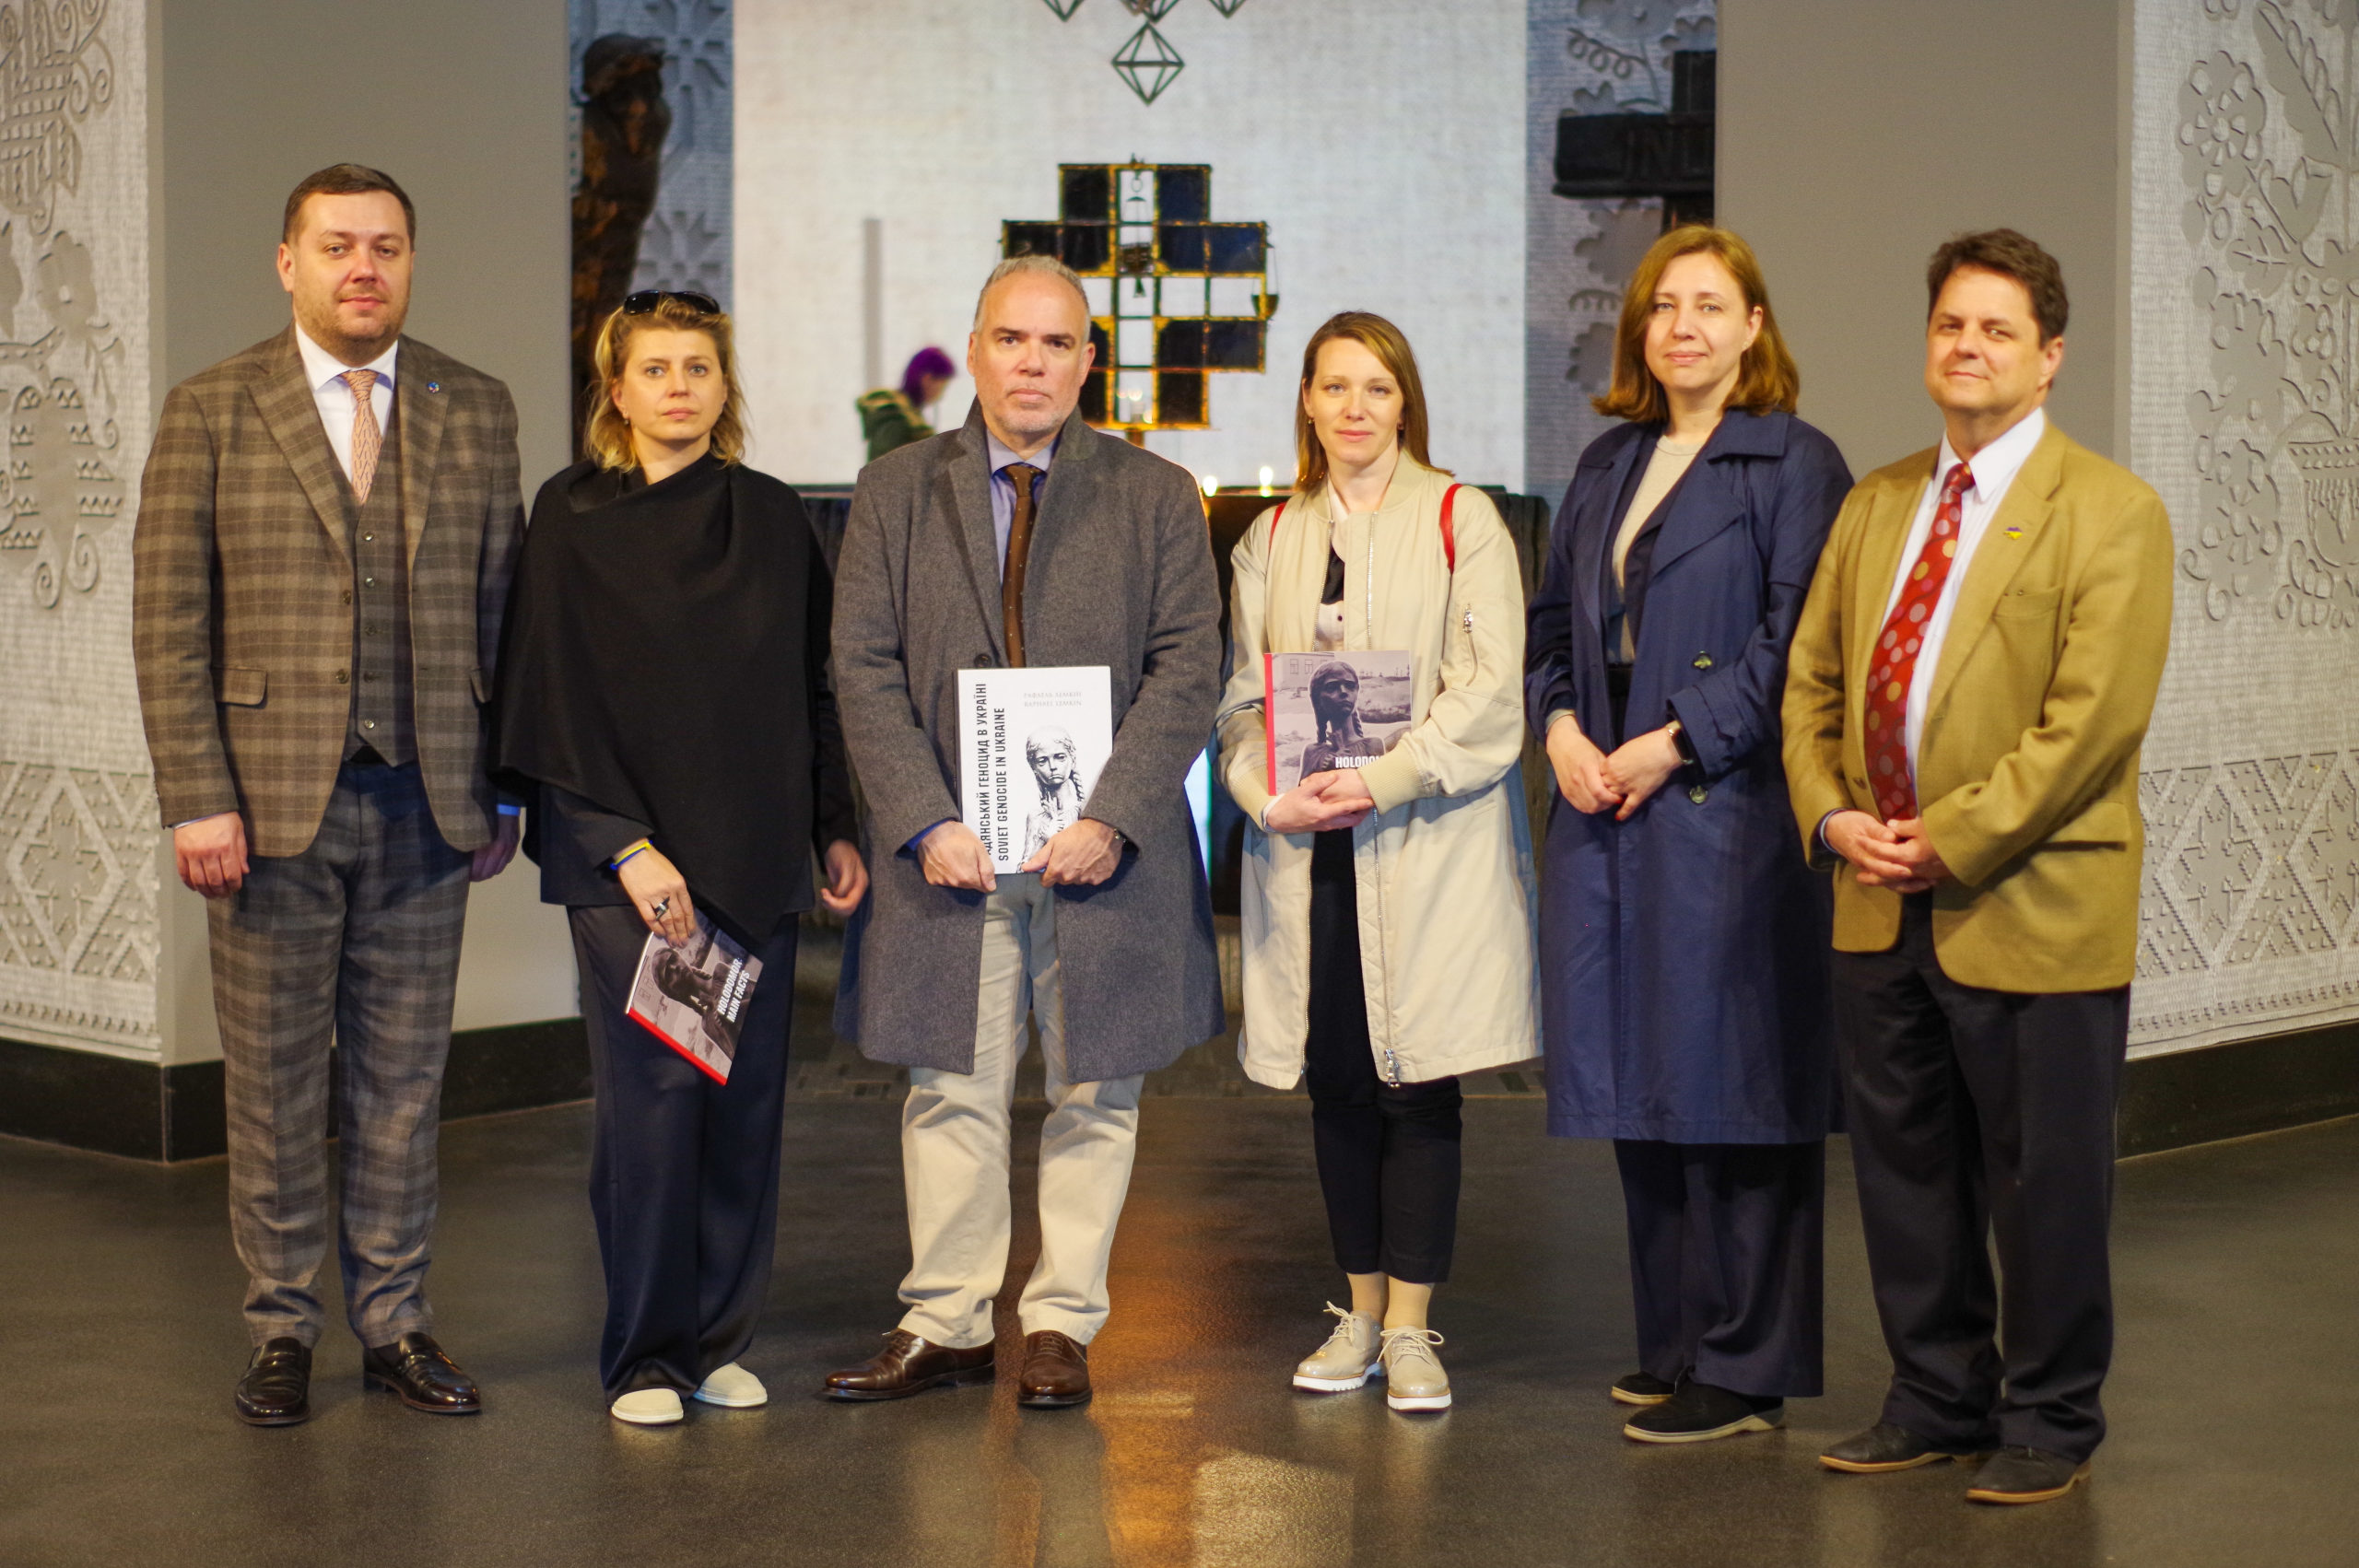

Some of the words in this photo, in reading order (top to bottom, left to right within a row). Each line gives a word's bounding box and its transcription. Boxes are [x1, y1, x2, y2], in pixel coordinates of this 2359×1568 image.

[973, 684, 989, 725] УКРАЇНІ
[993, 708, 1006, 753] UKRAINE
[977, 740, 991, 788] ГЕНОЦИД
[995, 756, 1007, 766] IN
[995, 771, 1008, 822] GENOCIDE
[976, 792, 993, 856] ДЯНСЬКИЙ
[997, 826, 1009, 861] SOVIET
[726, 997, 741, 1023] MAIN
[734, 970, 750, 1000] FACTS
